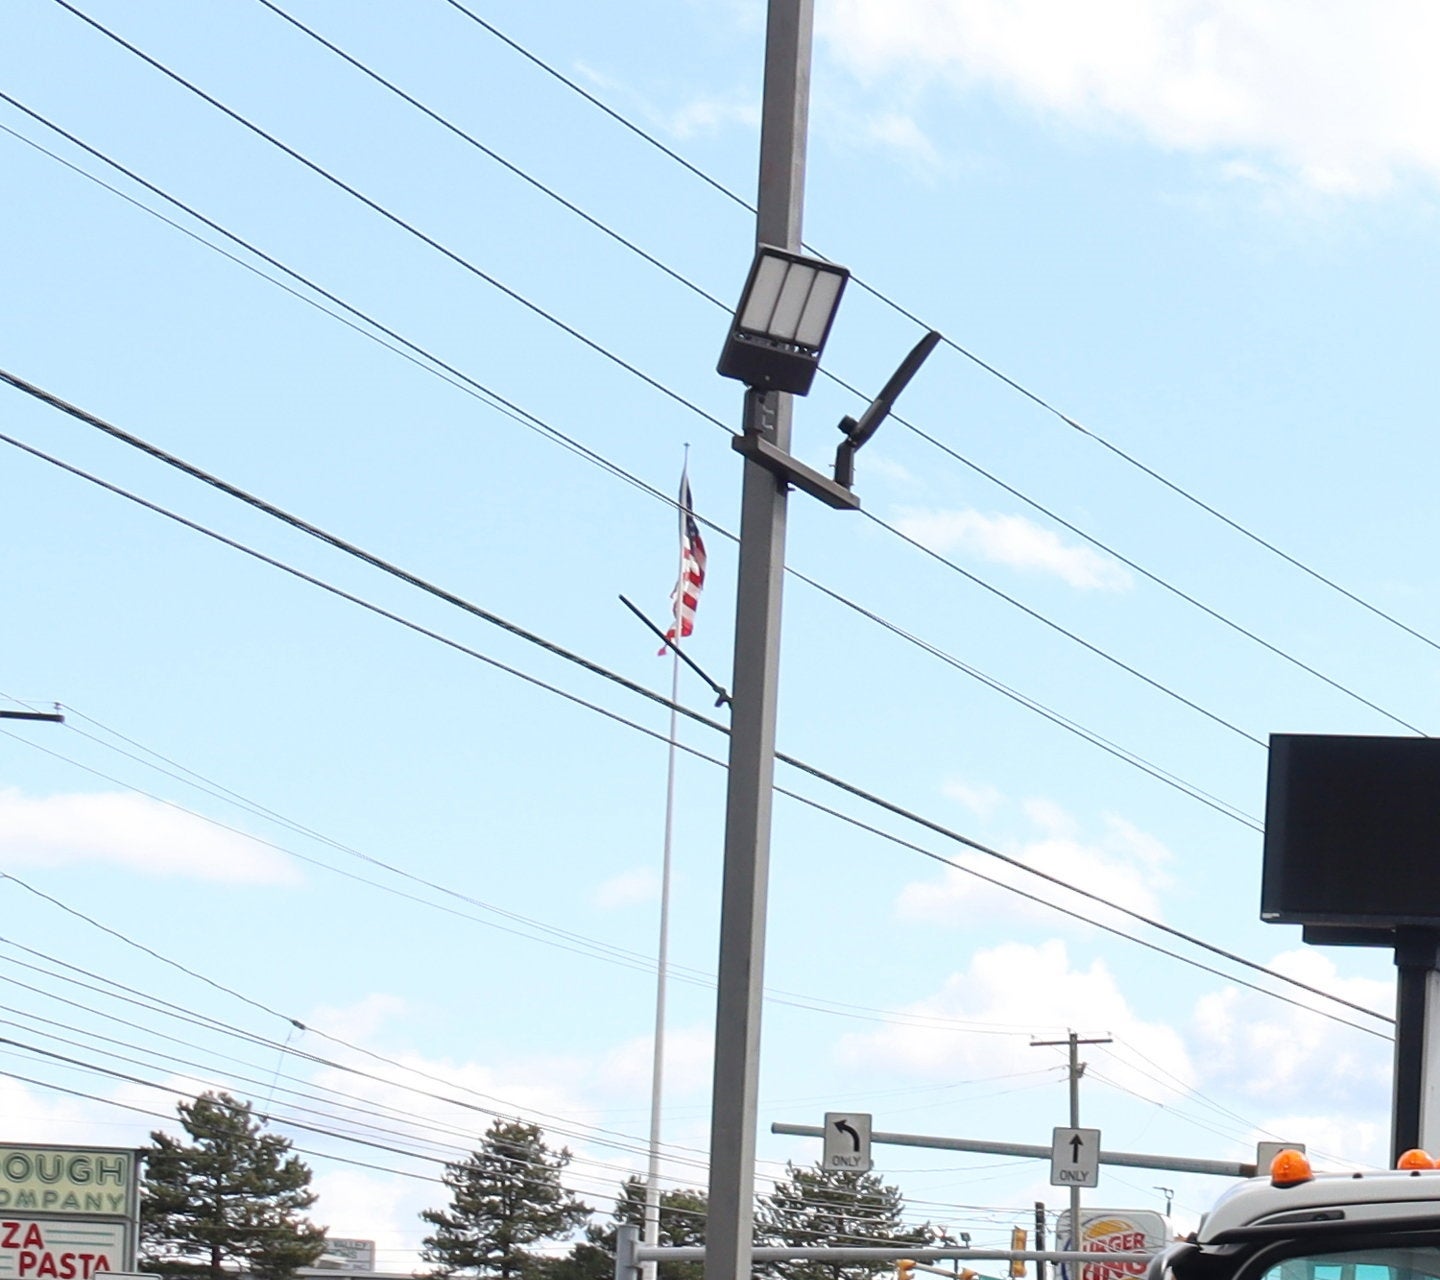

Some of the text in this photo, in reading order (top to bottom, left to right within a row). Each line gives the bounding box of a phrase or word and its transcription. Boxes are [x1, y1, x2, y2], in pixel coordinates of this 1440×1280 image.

[832, 1155, 861, 1167] ONLY
[1059, 1169, 1090, 1182] ONLY
[19, 1251, 111, 1280] PASTA
